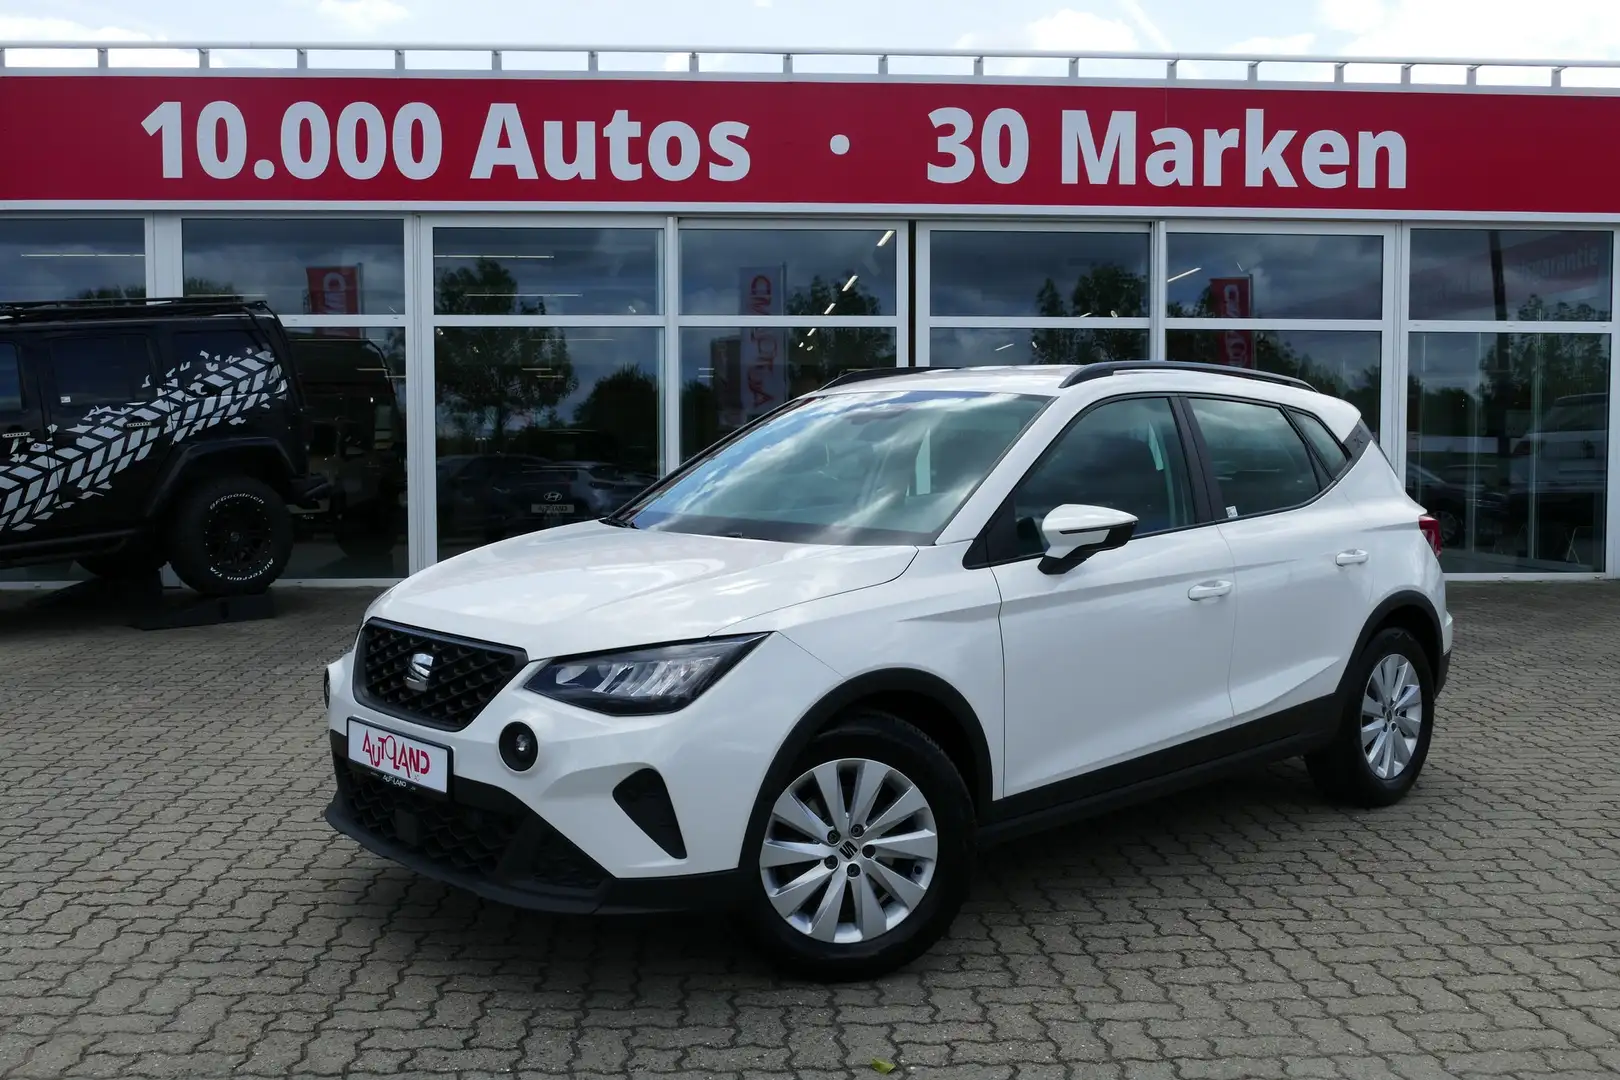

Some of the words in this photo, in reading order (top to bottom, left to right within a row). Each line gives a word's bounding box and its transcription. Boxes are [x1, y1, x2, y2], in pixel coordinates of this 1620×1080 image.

[141, 101, 442, 179] 10.000
[470, 103, 750, 181] Autos
[928, 107, 1030, 185] 30
[1062, 109, 1406, 189] Marken
[363, 730, 430, 778] AUTOLAND
